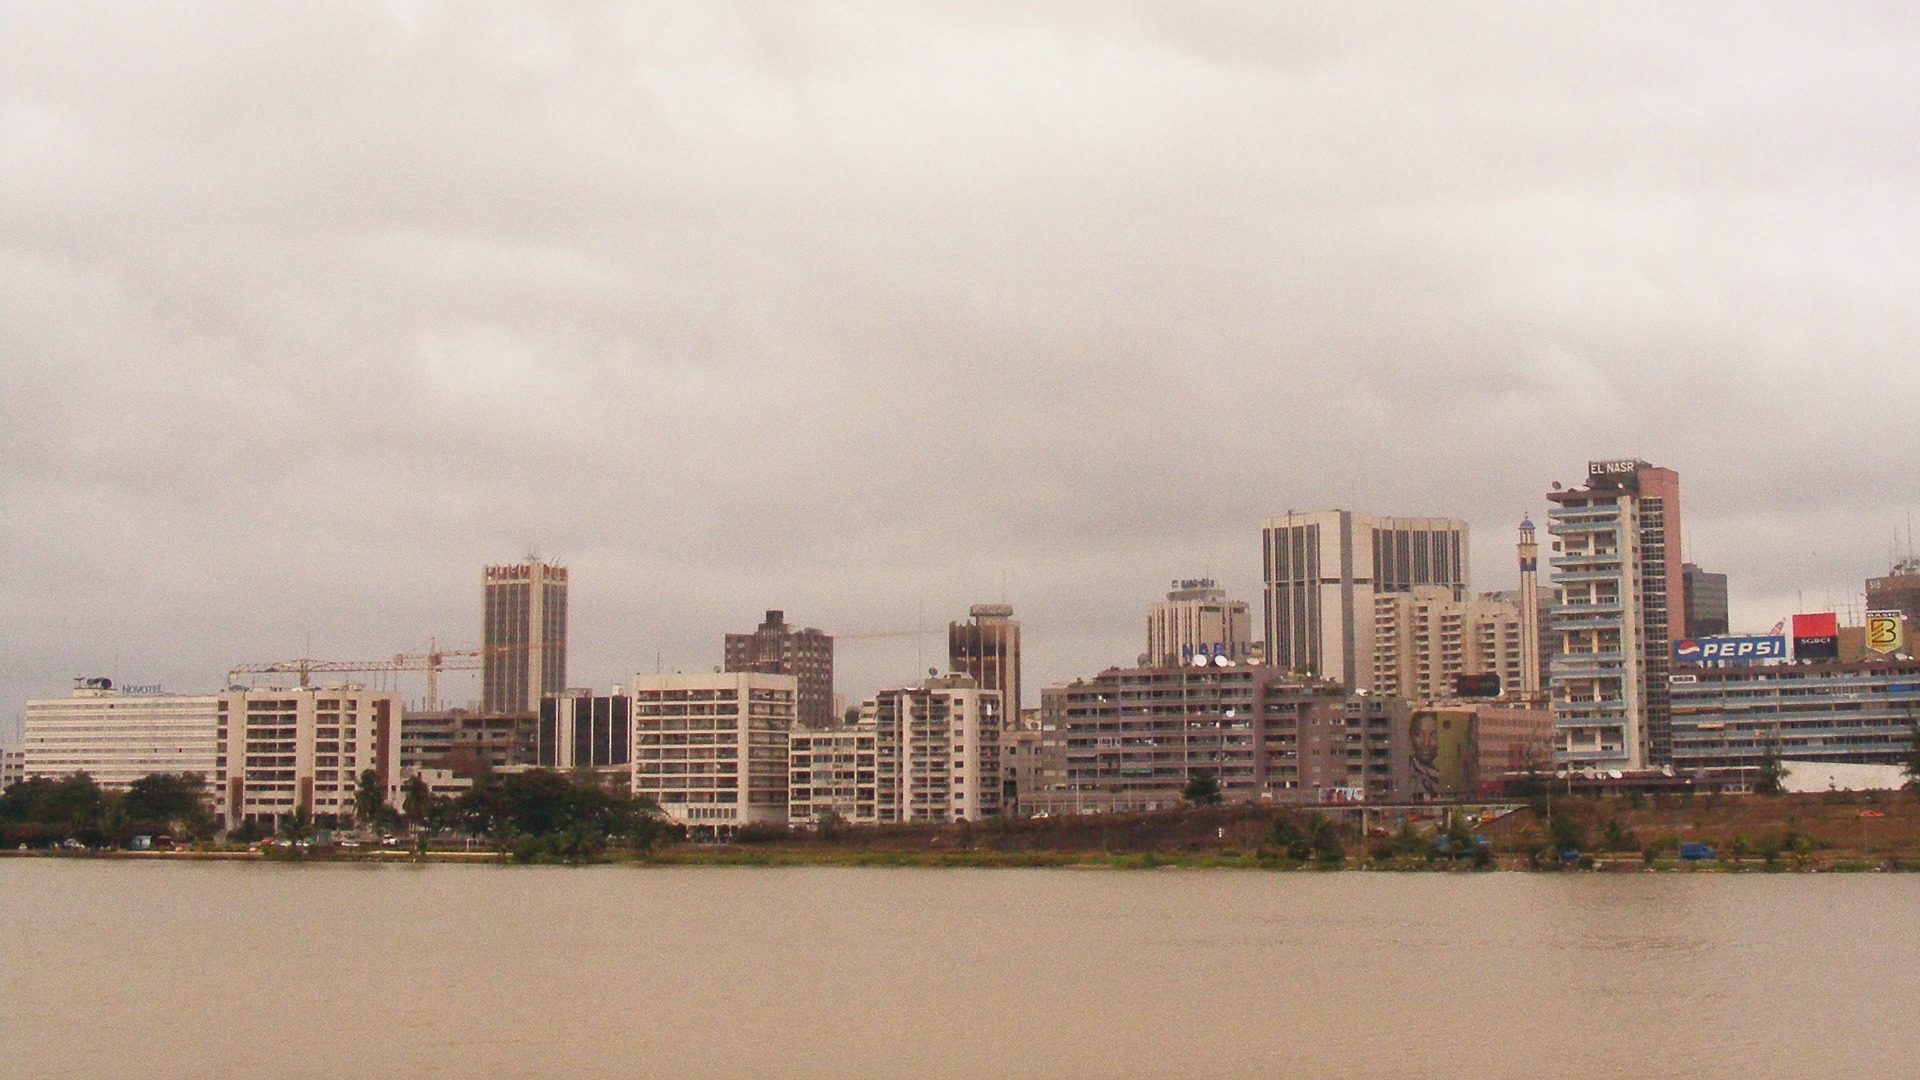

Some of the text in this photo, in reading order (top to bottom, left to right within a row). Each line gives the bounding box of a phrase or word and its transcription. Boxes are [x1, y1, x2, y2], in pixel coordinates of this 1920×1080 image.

[1591, 462, 1634, 474] EL NASR
[1182, 641, 1249, 658] NABIL
[1703, 641, 1780, 657] PEPSI
